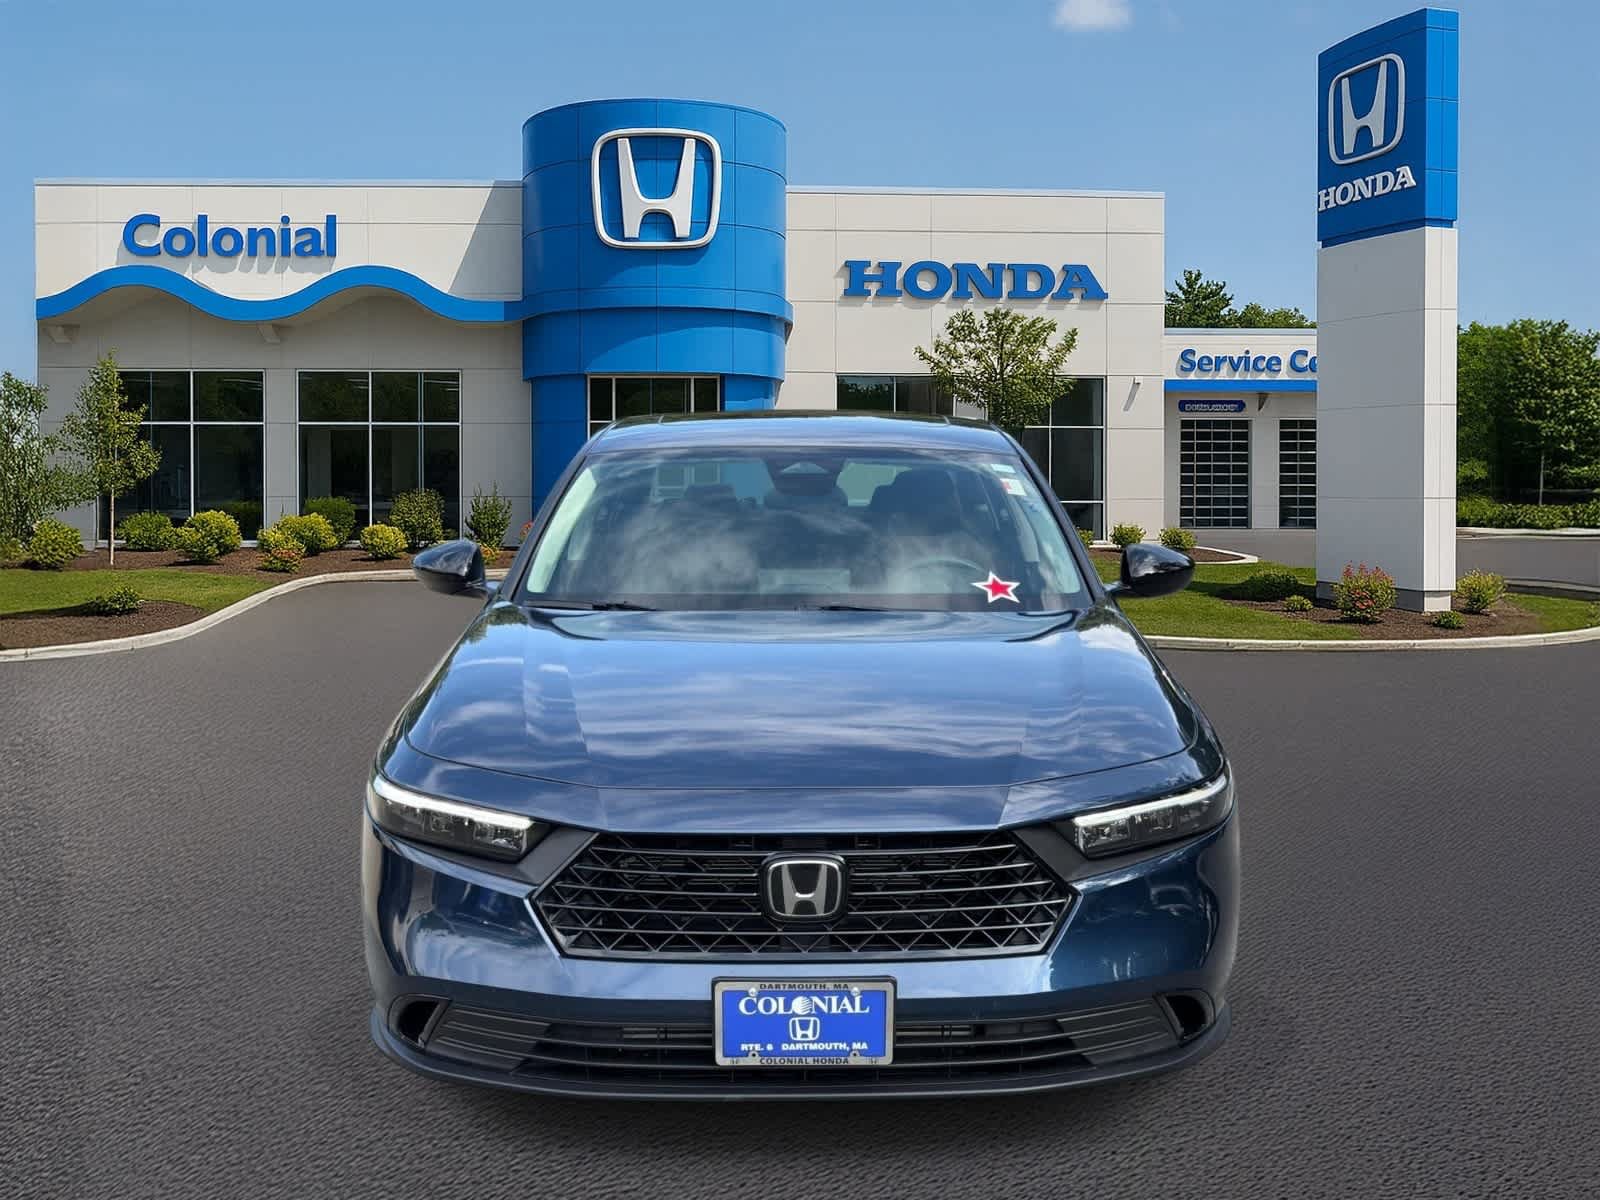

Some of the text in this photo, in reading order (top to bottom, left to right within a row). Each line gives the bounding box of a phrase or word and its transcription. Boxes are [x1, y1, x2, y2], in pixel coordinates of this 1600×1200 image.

[1318, 165, 1417, 212] HONDA
[122, 213, 337, 257] Colonial
[843, 260, 1109, 300] HONDA
[1180, 348, 1282, 373] Service
[759, 983, 830, 991] DARTMOUTH,
[738, 995, 870, 1015] COLONIAL
[741, 1043, 764, 1051] RTE.
[781, 1041, 850, 1051] DARTMOUTH,
[852, 1042, 868, 1050] MA
[759, 1057, 849, 1065] COLONIAL HONDA
